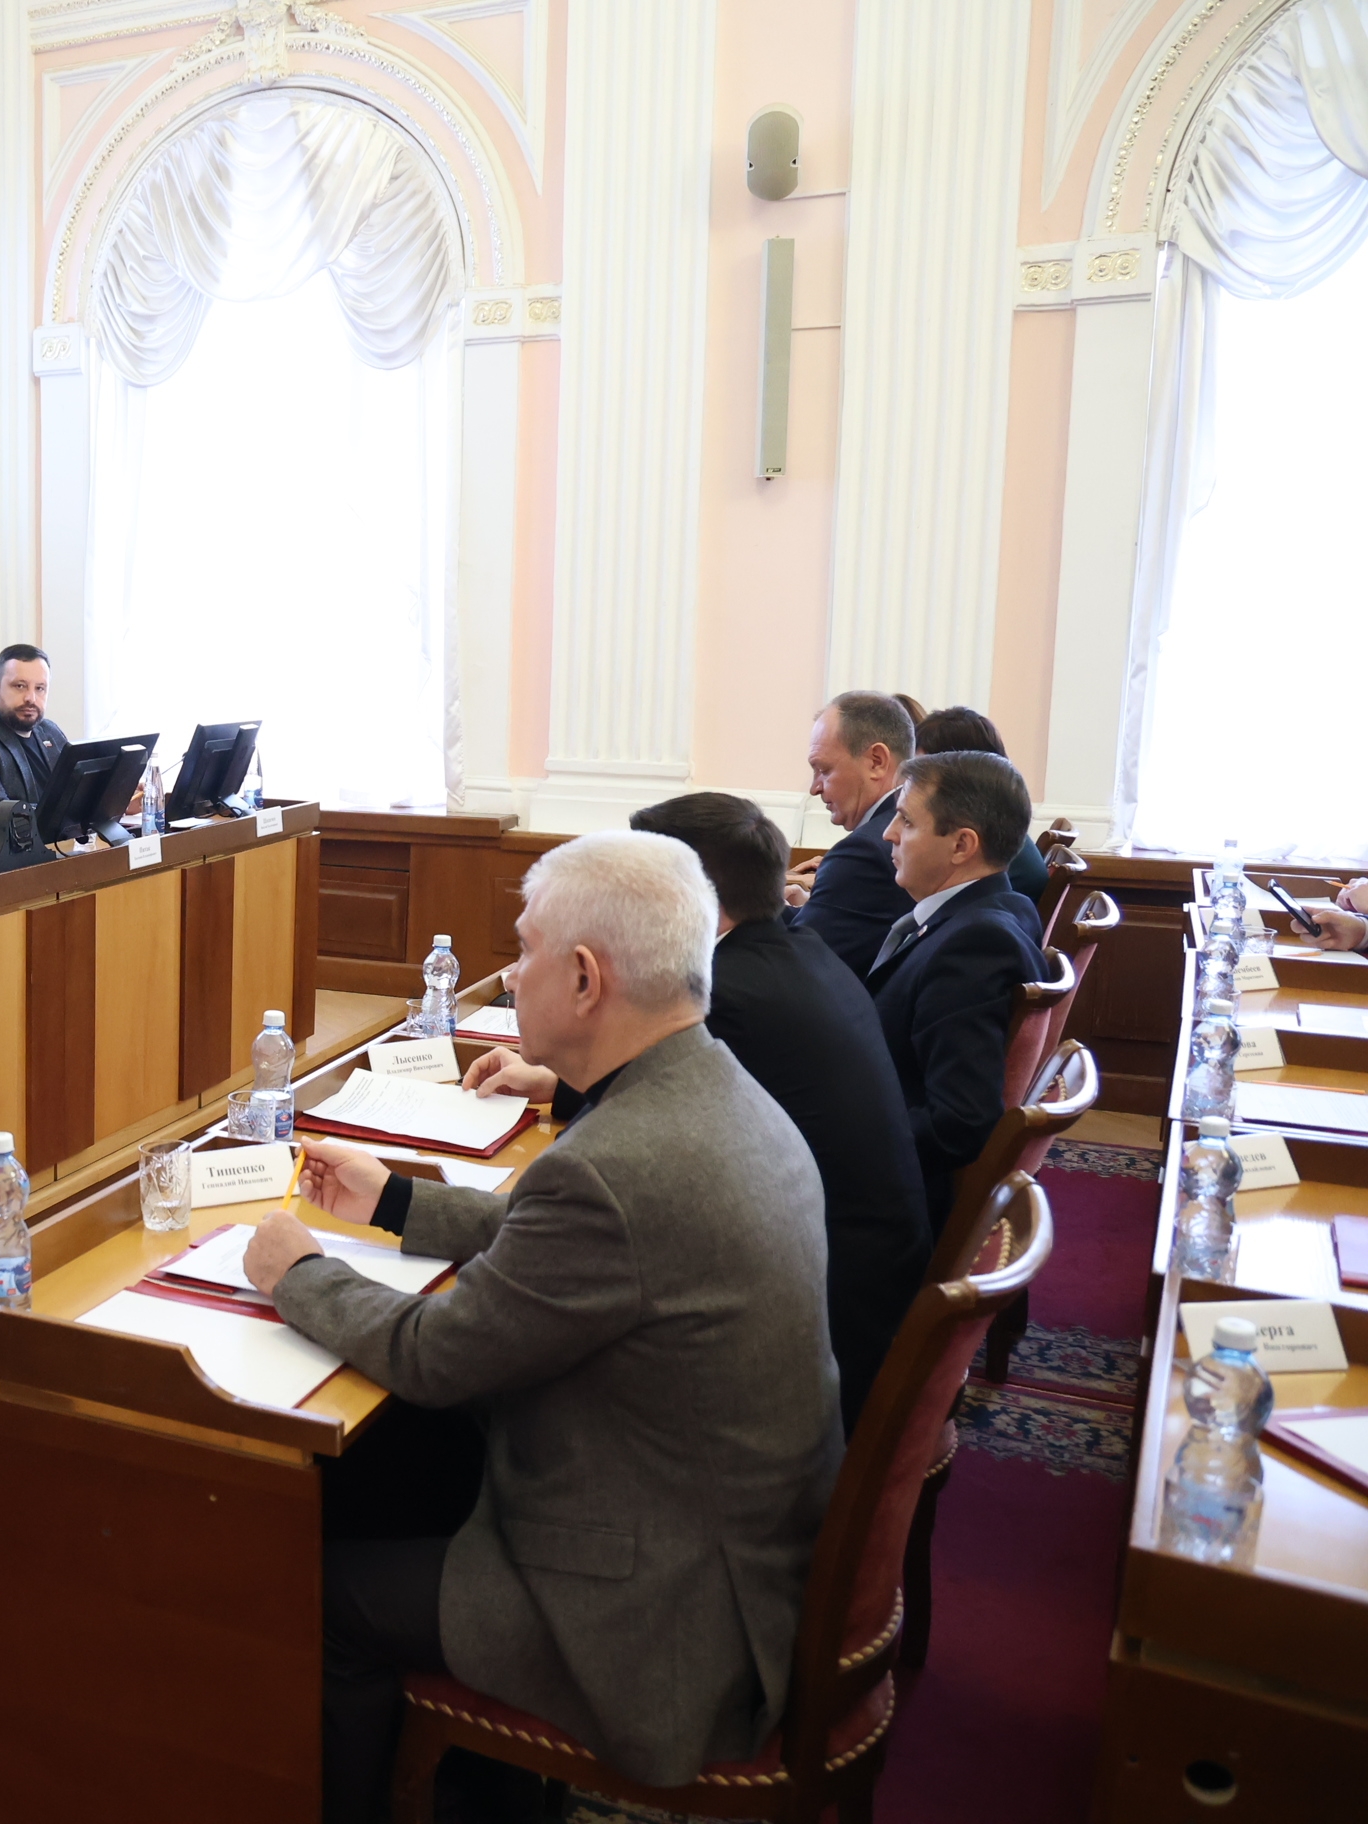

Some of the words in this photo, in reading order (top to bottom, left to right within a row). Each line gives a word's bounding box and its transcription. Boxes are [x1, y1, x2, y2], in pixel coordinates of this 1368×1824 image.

[392, 1053, 433, 1066] Лысенко
[386, 1066, 412, 1075] Владимир
[413, 1062, 444, 1072] Викторович
[206, 1163, 266, 1178] Тищенко
[201, 1180, 237, 1190] Геннадий
[238, 1176, 274, 1186] Иванович
[1256, 1325, 1295, 1340] ерга
